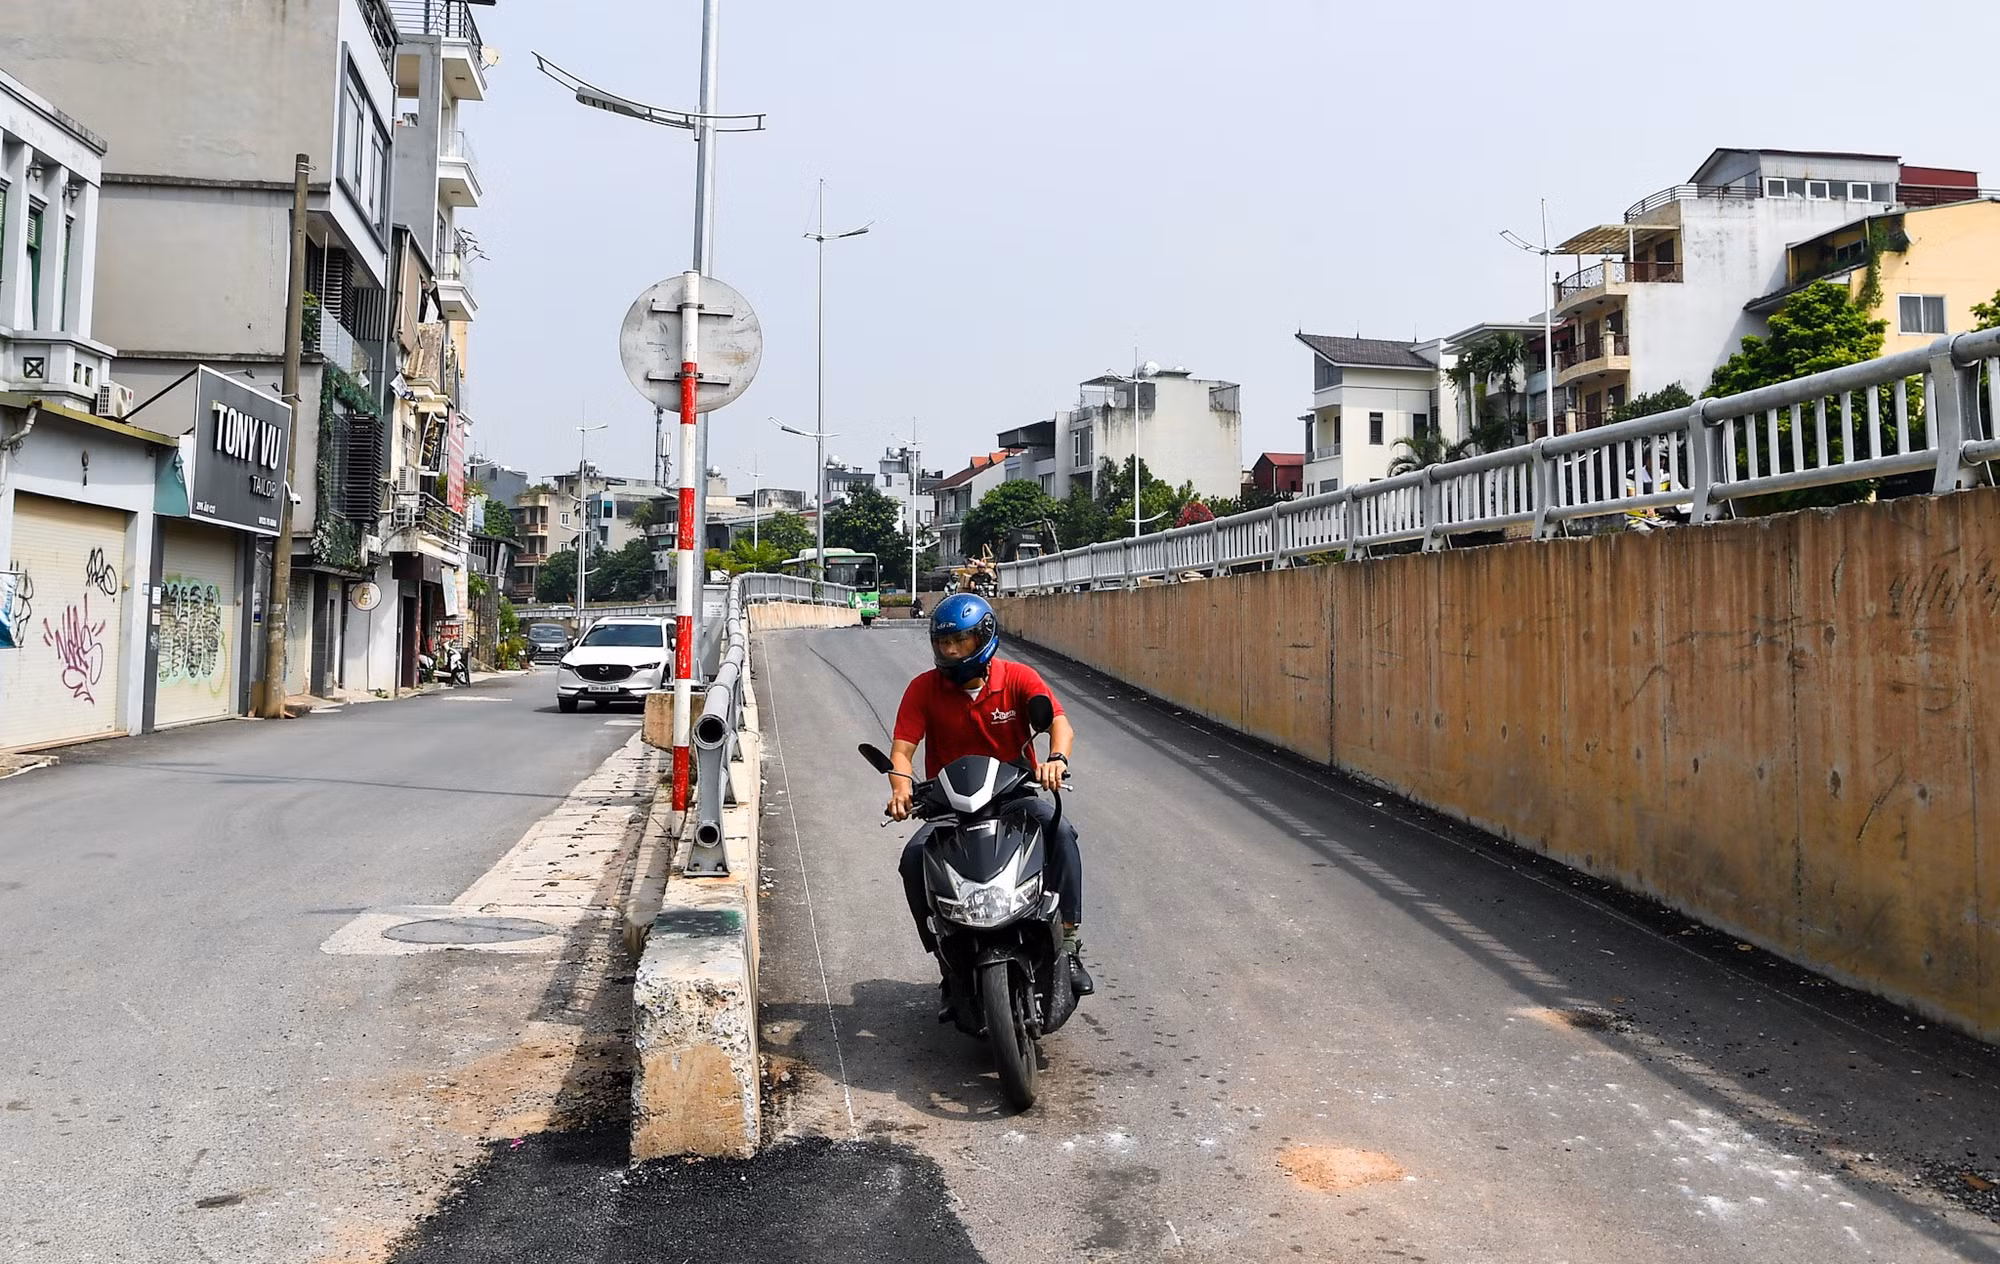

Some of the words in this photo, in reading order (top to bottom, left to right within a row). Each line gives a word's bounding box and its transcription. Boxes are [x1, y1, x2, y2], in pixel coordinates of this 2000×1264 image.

[212, 401, 260, 462] TONY
[261, 421, 282, 470] VU
[966, 823, 990, 831] HONDA
